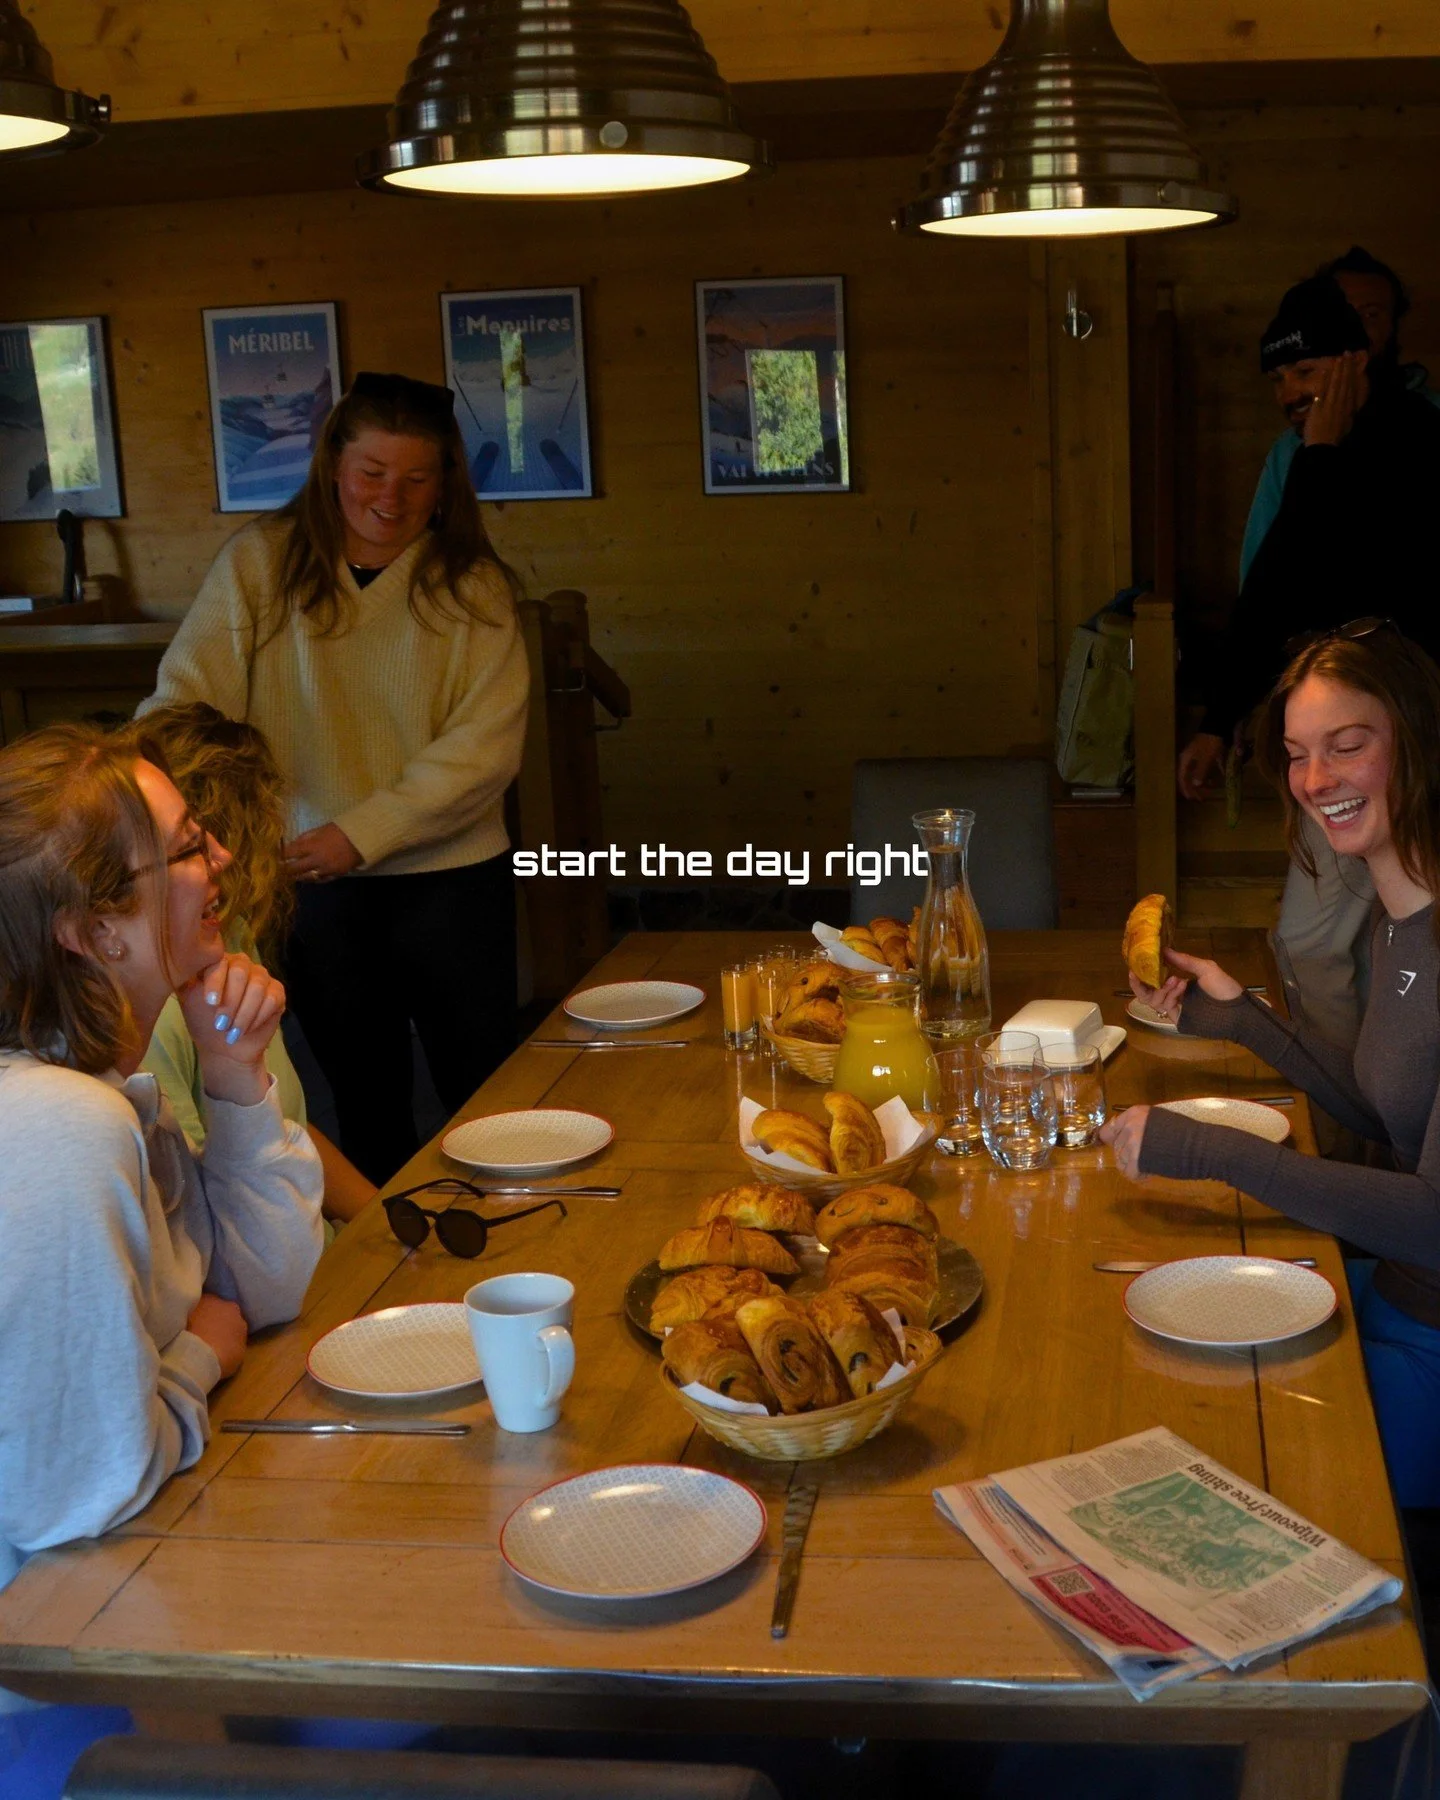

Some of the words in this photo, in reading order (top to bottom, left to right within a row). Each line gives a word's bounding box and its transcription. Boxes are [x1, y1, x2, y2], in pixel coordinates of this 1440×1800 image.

[466, 314, 570, 336] Menuires
[228, 327, 314, 355] MÉRIBEL
[1188, 1463, 1234, 1493] skiing
[1230, 1487, 1327, 1548] Wipeout-free
